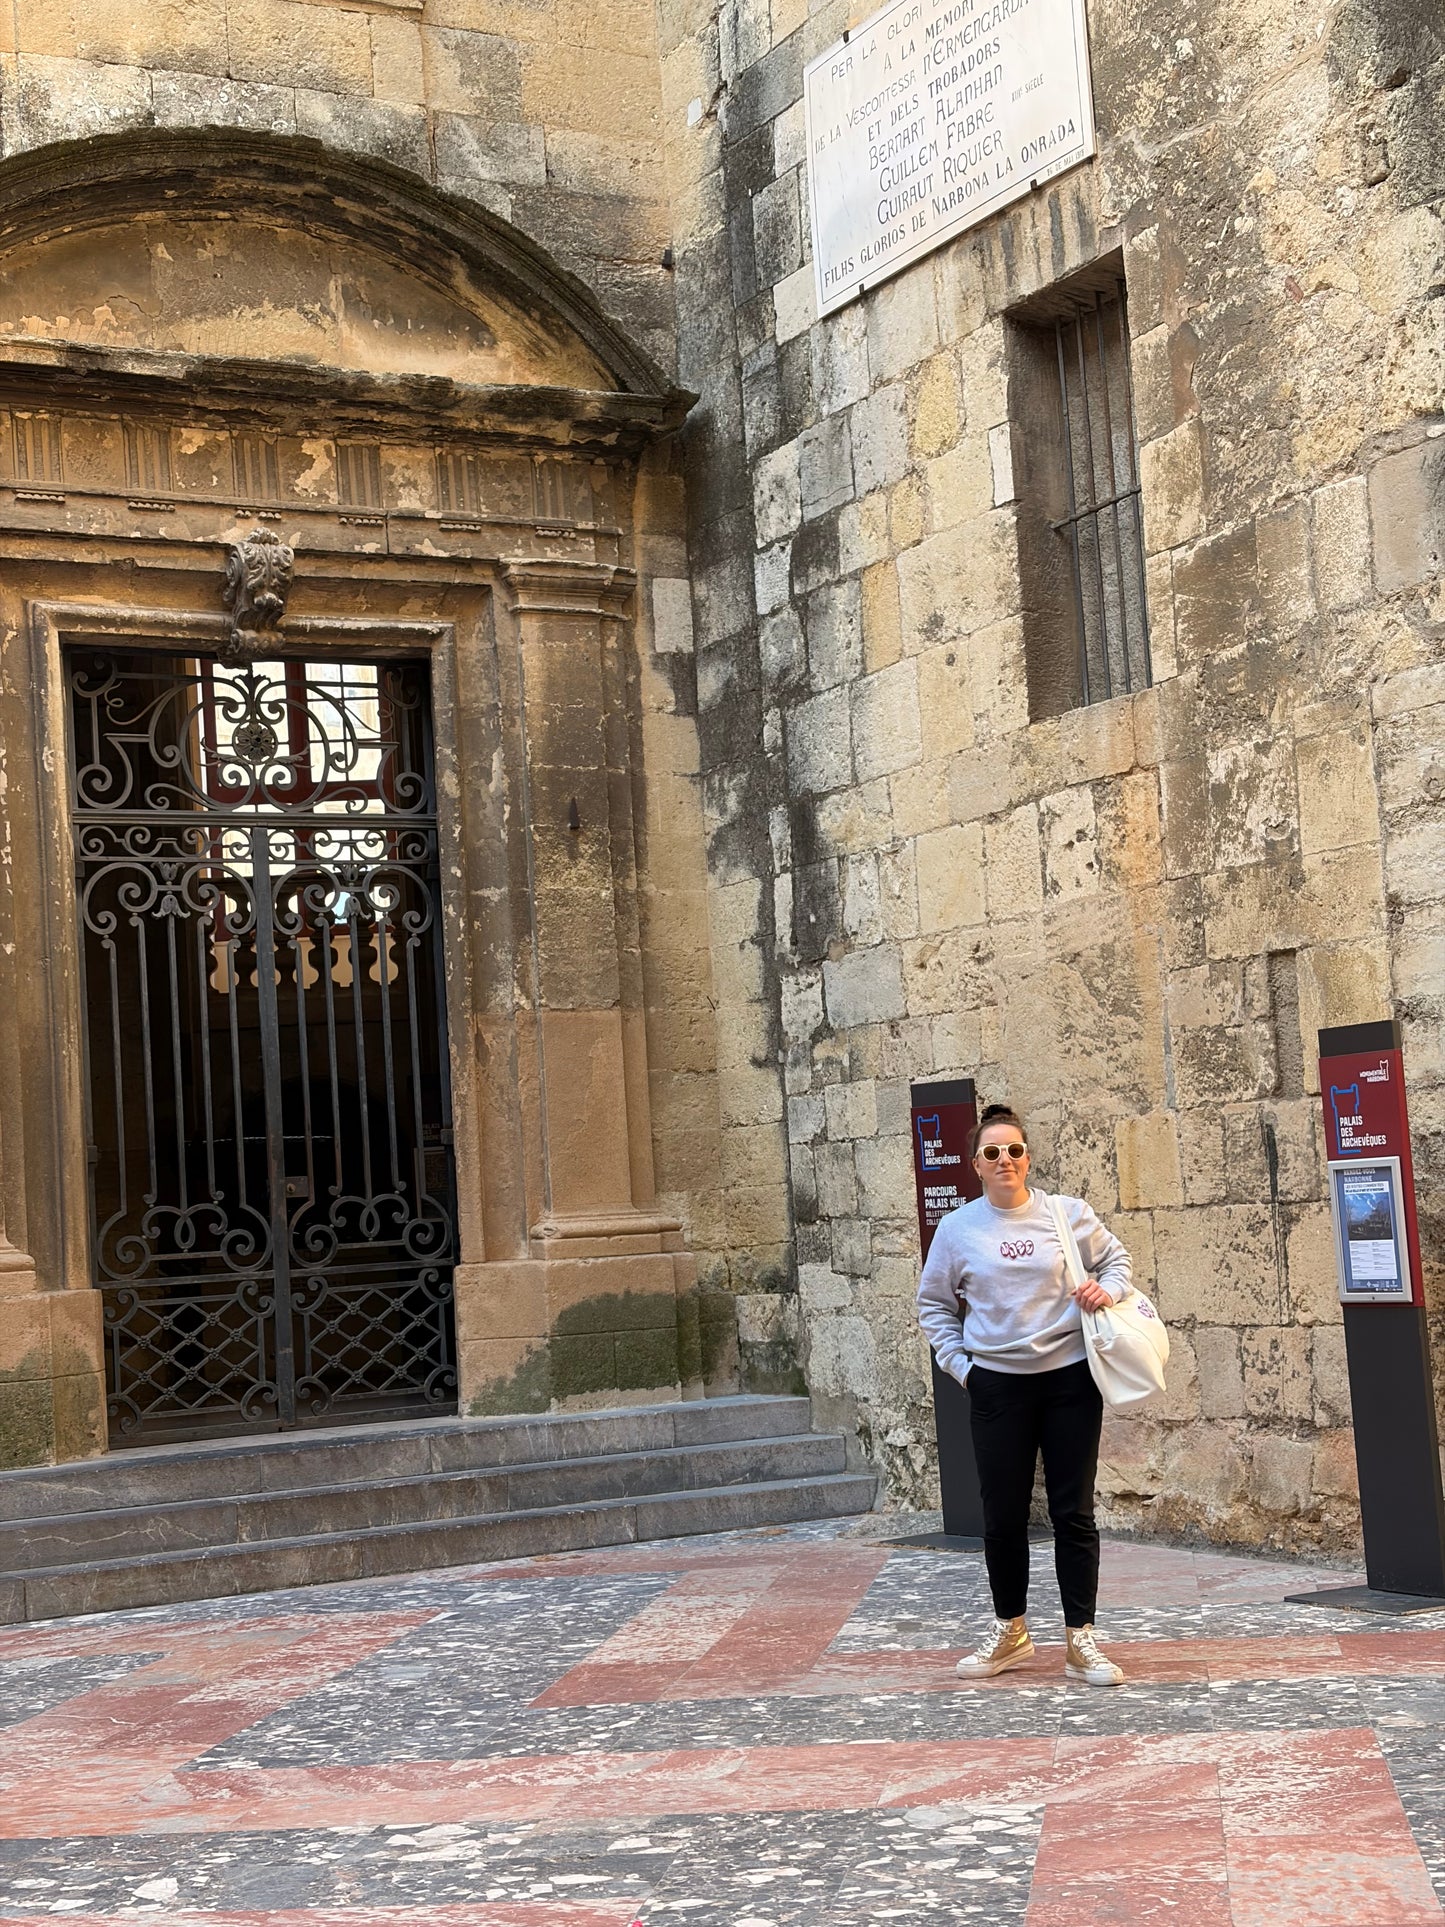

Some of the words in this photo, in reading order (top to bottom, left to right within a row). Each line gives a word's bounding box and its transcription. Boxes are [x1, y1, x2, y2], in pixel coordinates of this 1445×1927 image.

[831, 57, 853, 83] PER
[862, 40, 877, 60] LA
[887, 3, 922, 40] GLORI
[884, 52, 892, 73] A
[901, 40, 915, 60] LA
[925, 0, 973, 43] MEMORI
[868, 120, 881, 142] ET
[890, 94, 919, 126] DELS
[928, 37, 1000, 99] TROBADORS
[815, 136, 826, 154] DE
[830, 125, 841, 143] LA
[880, 140, 939, 192] GUILLEM
[947, 102, 994, 151] FABRE
[877, 173, 933, 225] GUIRAUT
[943, 130, 1003, 184] RIQUIER
[824, 257, 854, 288] FILHS
[860, 224, 906, 264] GLORIOS
[911, 210, 926, 232] DE
[932, 171, 989, 220] NARBONA
[996, 156, 1013, 179] LA
[1021, 118, 1075, 163] ONRADA
[1340, 1116, 1363, 1126] PALAIS
[1340, 1127, 1353, 1137] DES
[924, 1140, 942, 1148] PALAIS
[1342, 1133, 1386, 1148] ARCHEVÊQUES
[925, 1149, 935, 1157] DES
[925, 1154, 960, 1165] ARCHEVÊQUES
[924, 1185, 957, 1197] PARCOURS
[925, 1198, 948, 1209] PALAIS
